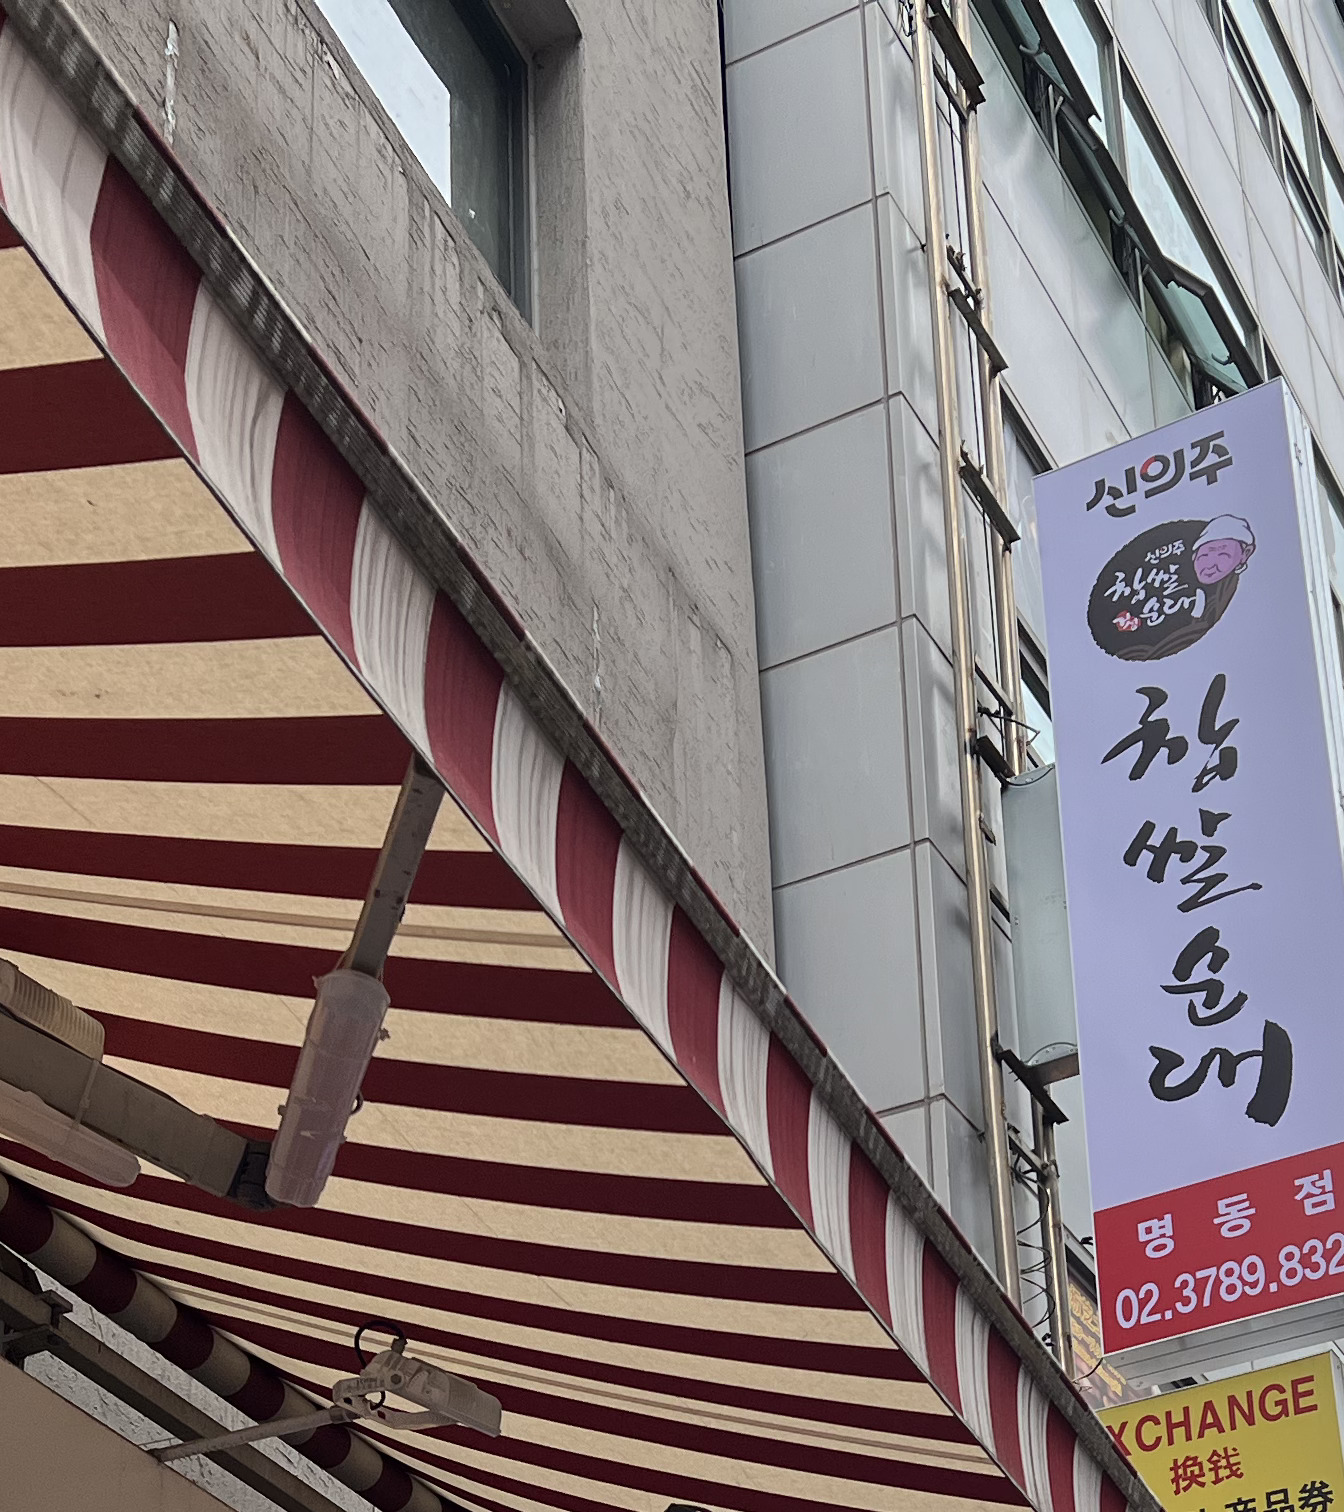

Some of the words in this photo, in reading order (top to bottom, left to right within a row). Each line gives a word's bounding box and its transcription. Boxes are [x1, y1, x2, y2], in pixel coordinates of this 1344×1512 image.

[1086, 430, 1234, 518] 신의주
[1137, 1168, 1336, 1260] 명동점
[1106, 1375, 1320, 1458] XCHANGE
